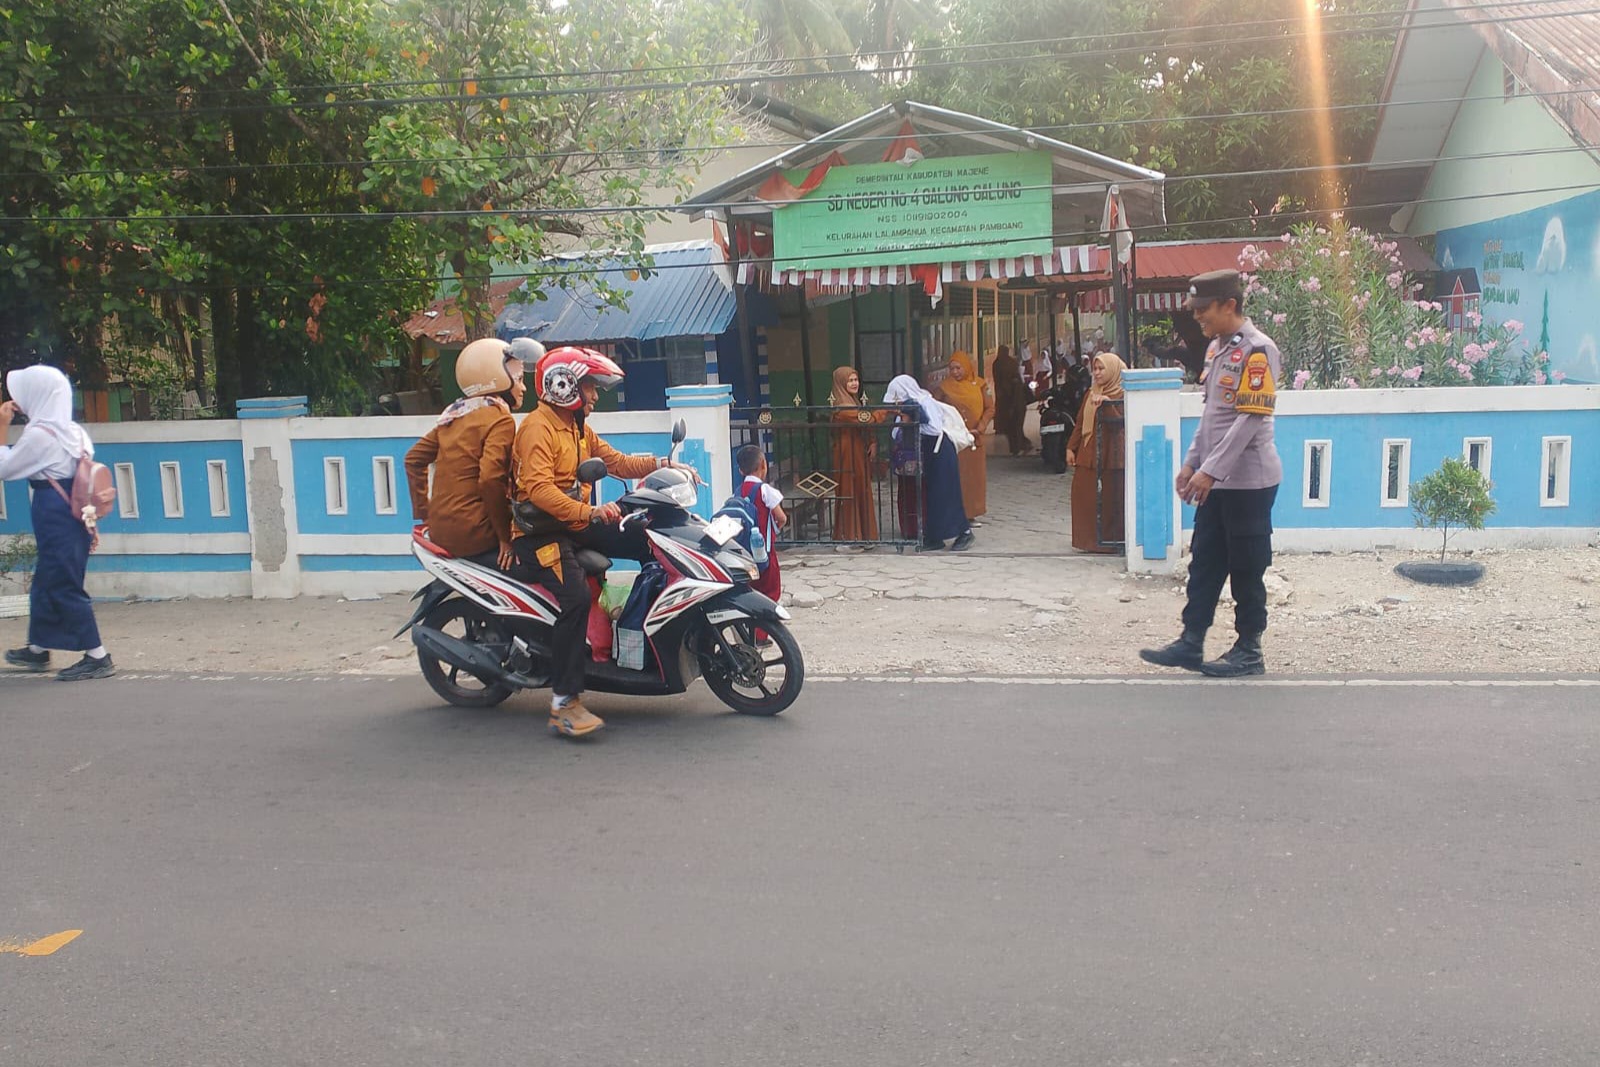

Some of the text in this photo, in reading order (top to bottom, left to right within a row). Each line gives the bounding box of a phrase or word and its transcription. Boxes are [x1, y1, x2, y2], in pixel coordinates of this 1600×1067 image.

[907, 169, 953, 180] KABUPATEN
[957, 166, 989, 176] MAJENE
[827, 193, 843, 212] SD
[846, 190, 887, 211] NEGERI
[910, 187, 919, 206] 4
[922, 184, 969, 205] GALUNG
[973, 181, 1022, 202] GALUNG
[877, 215, 897, 223] NSS
[826, 231, 872, 241] KELURAHAN
[930, 224, 976, 235] KECAMATAN
[979, 221, 1024, 232] PAMBOANG
